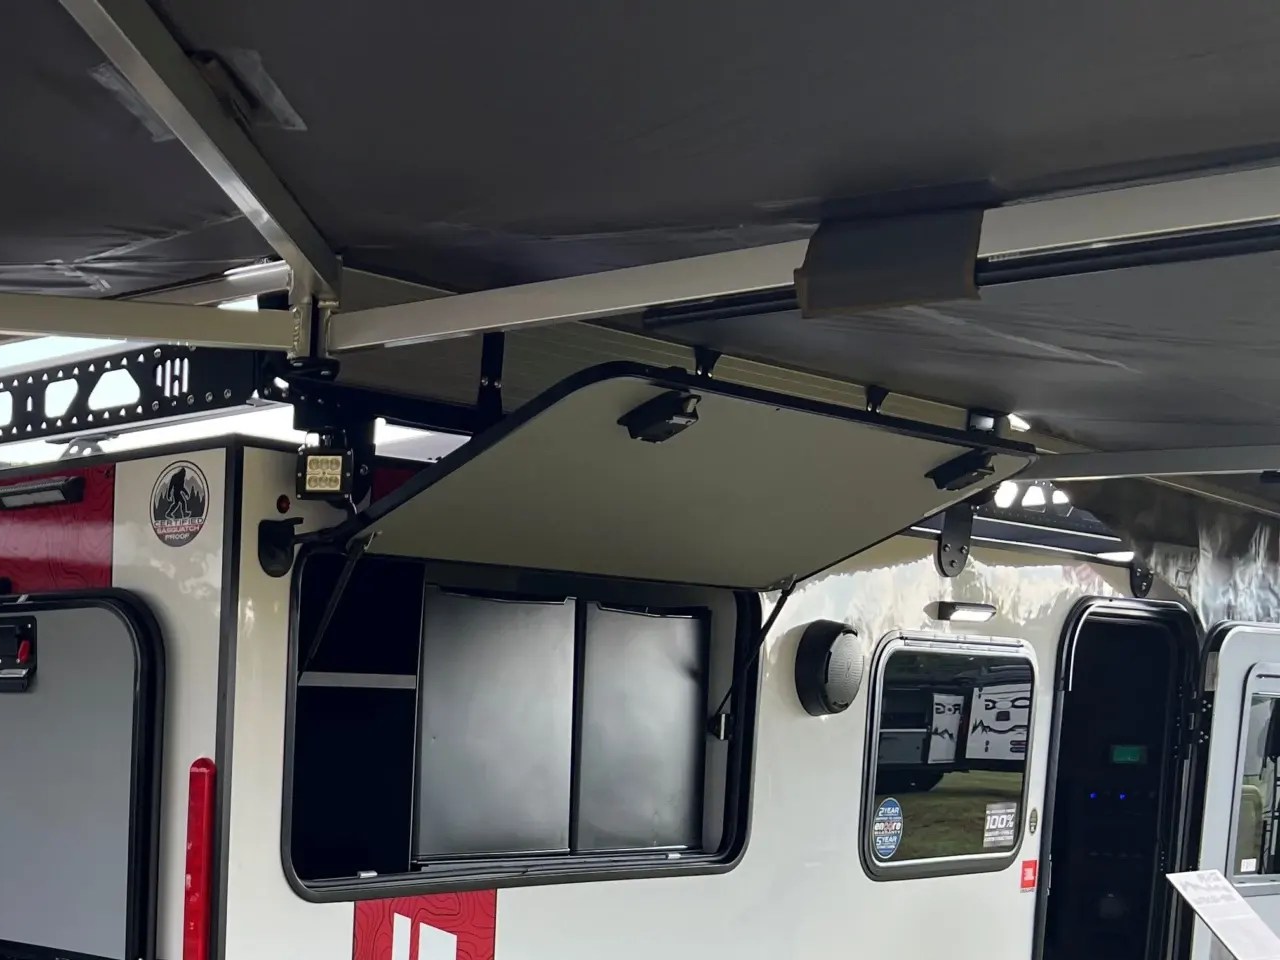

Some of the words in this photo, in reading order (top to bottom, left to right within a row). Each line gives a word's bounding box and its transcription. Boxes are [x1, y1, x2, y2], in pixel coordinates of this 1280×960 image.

[154, 517, 204, 529] CERTIFIED
[156, 524, 201, 534] SASQUATCH
[164, 533, 190, 541] PROOF
[985, 814, 1015, 830] 100%
